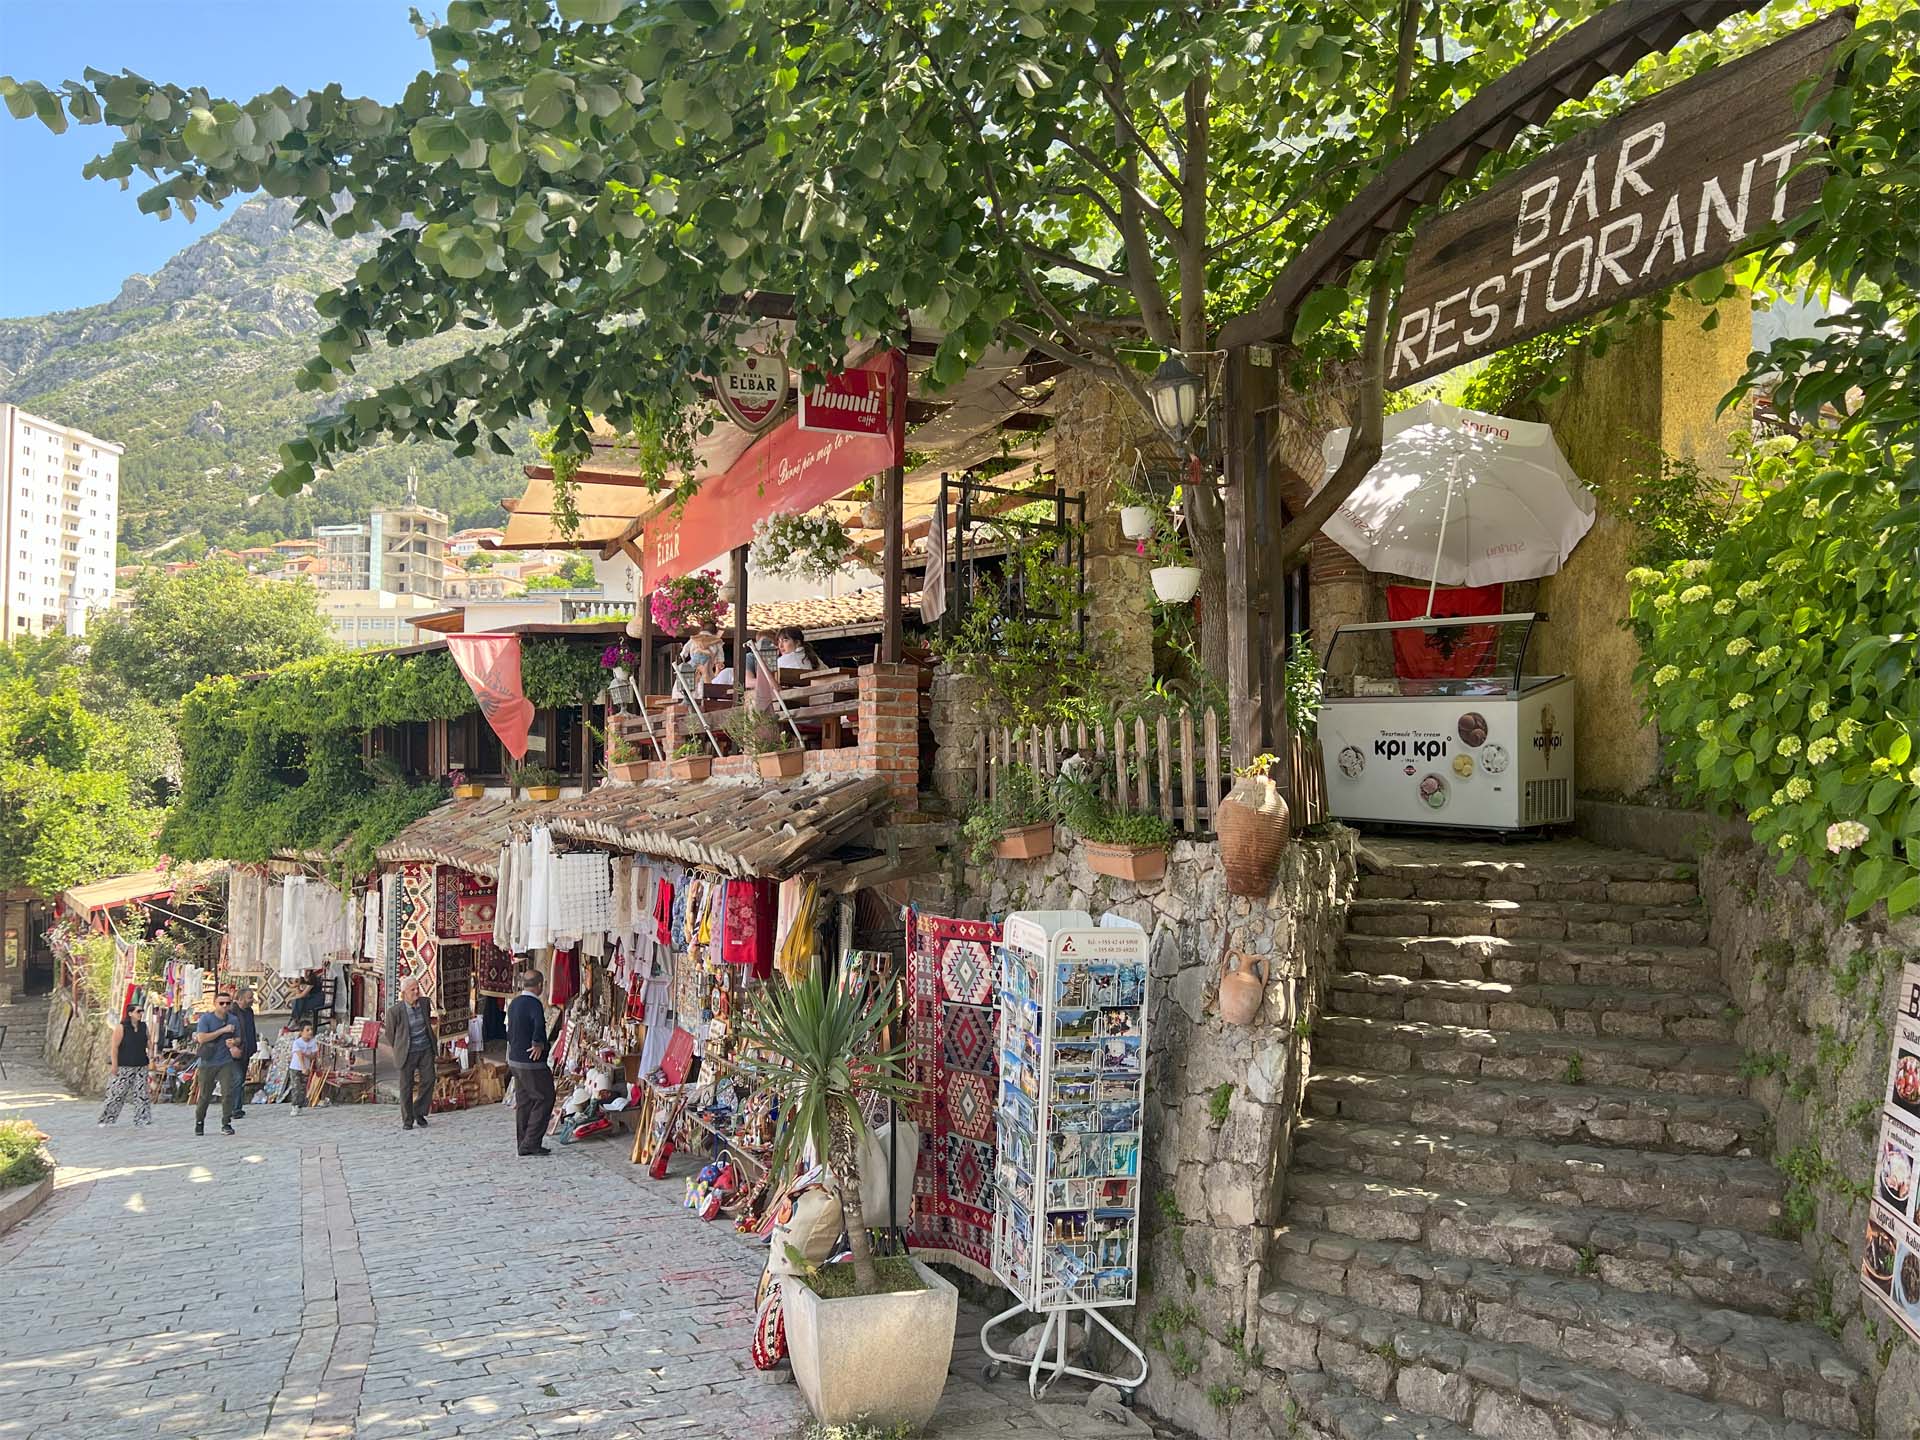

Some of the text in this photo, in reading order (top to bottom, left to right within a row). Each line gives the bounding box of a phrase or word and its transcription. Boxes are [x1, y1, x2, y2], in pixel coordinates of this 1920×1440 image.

[1512, 121, 1666, 257] BAR
[1389, 134, 1826, 380] RESTORANT
[730, 375, 777, 392] ELBAR
[811, 384, 880, 414] Buondi
[656, 533, 681, 568] ELBAR
[1909, 983, 1920, 1022] B
